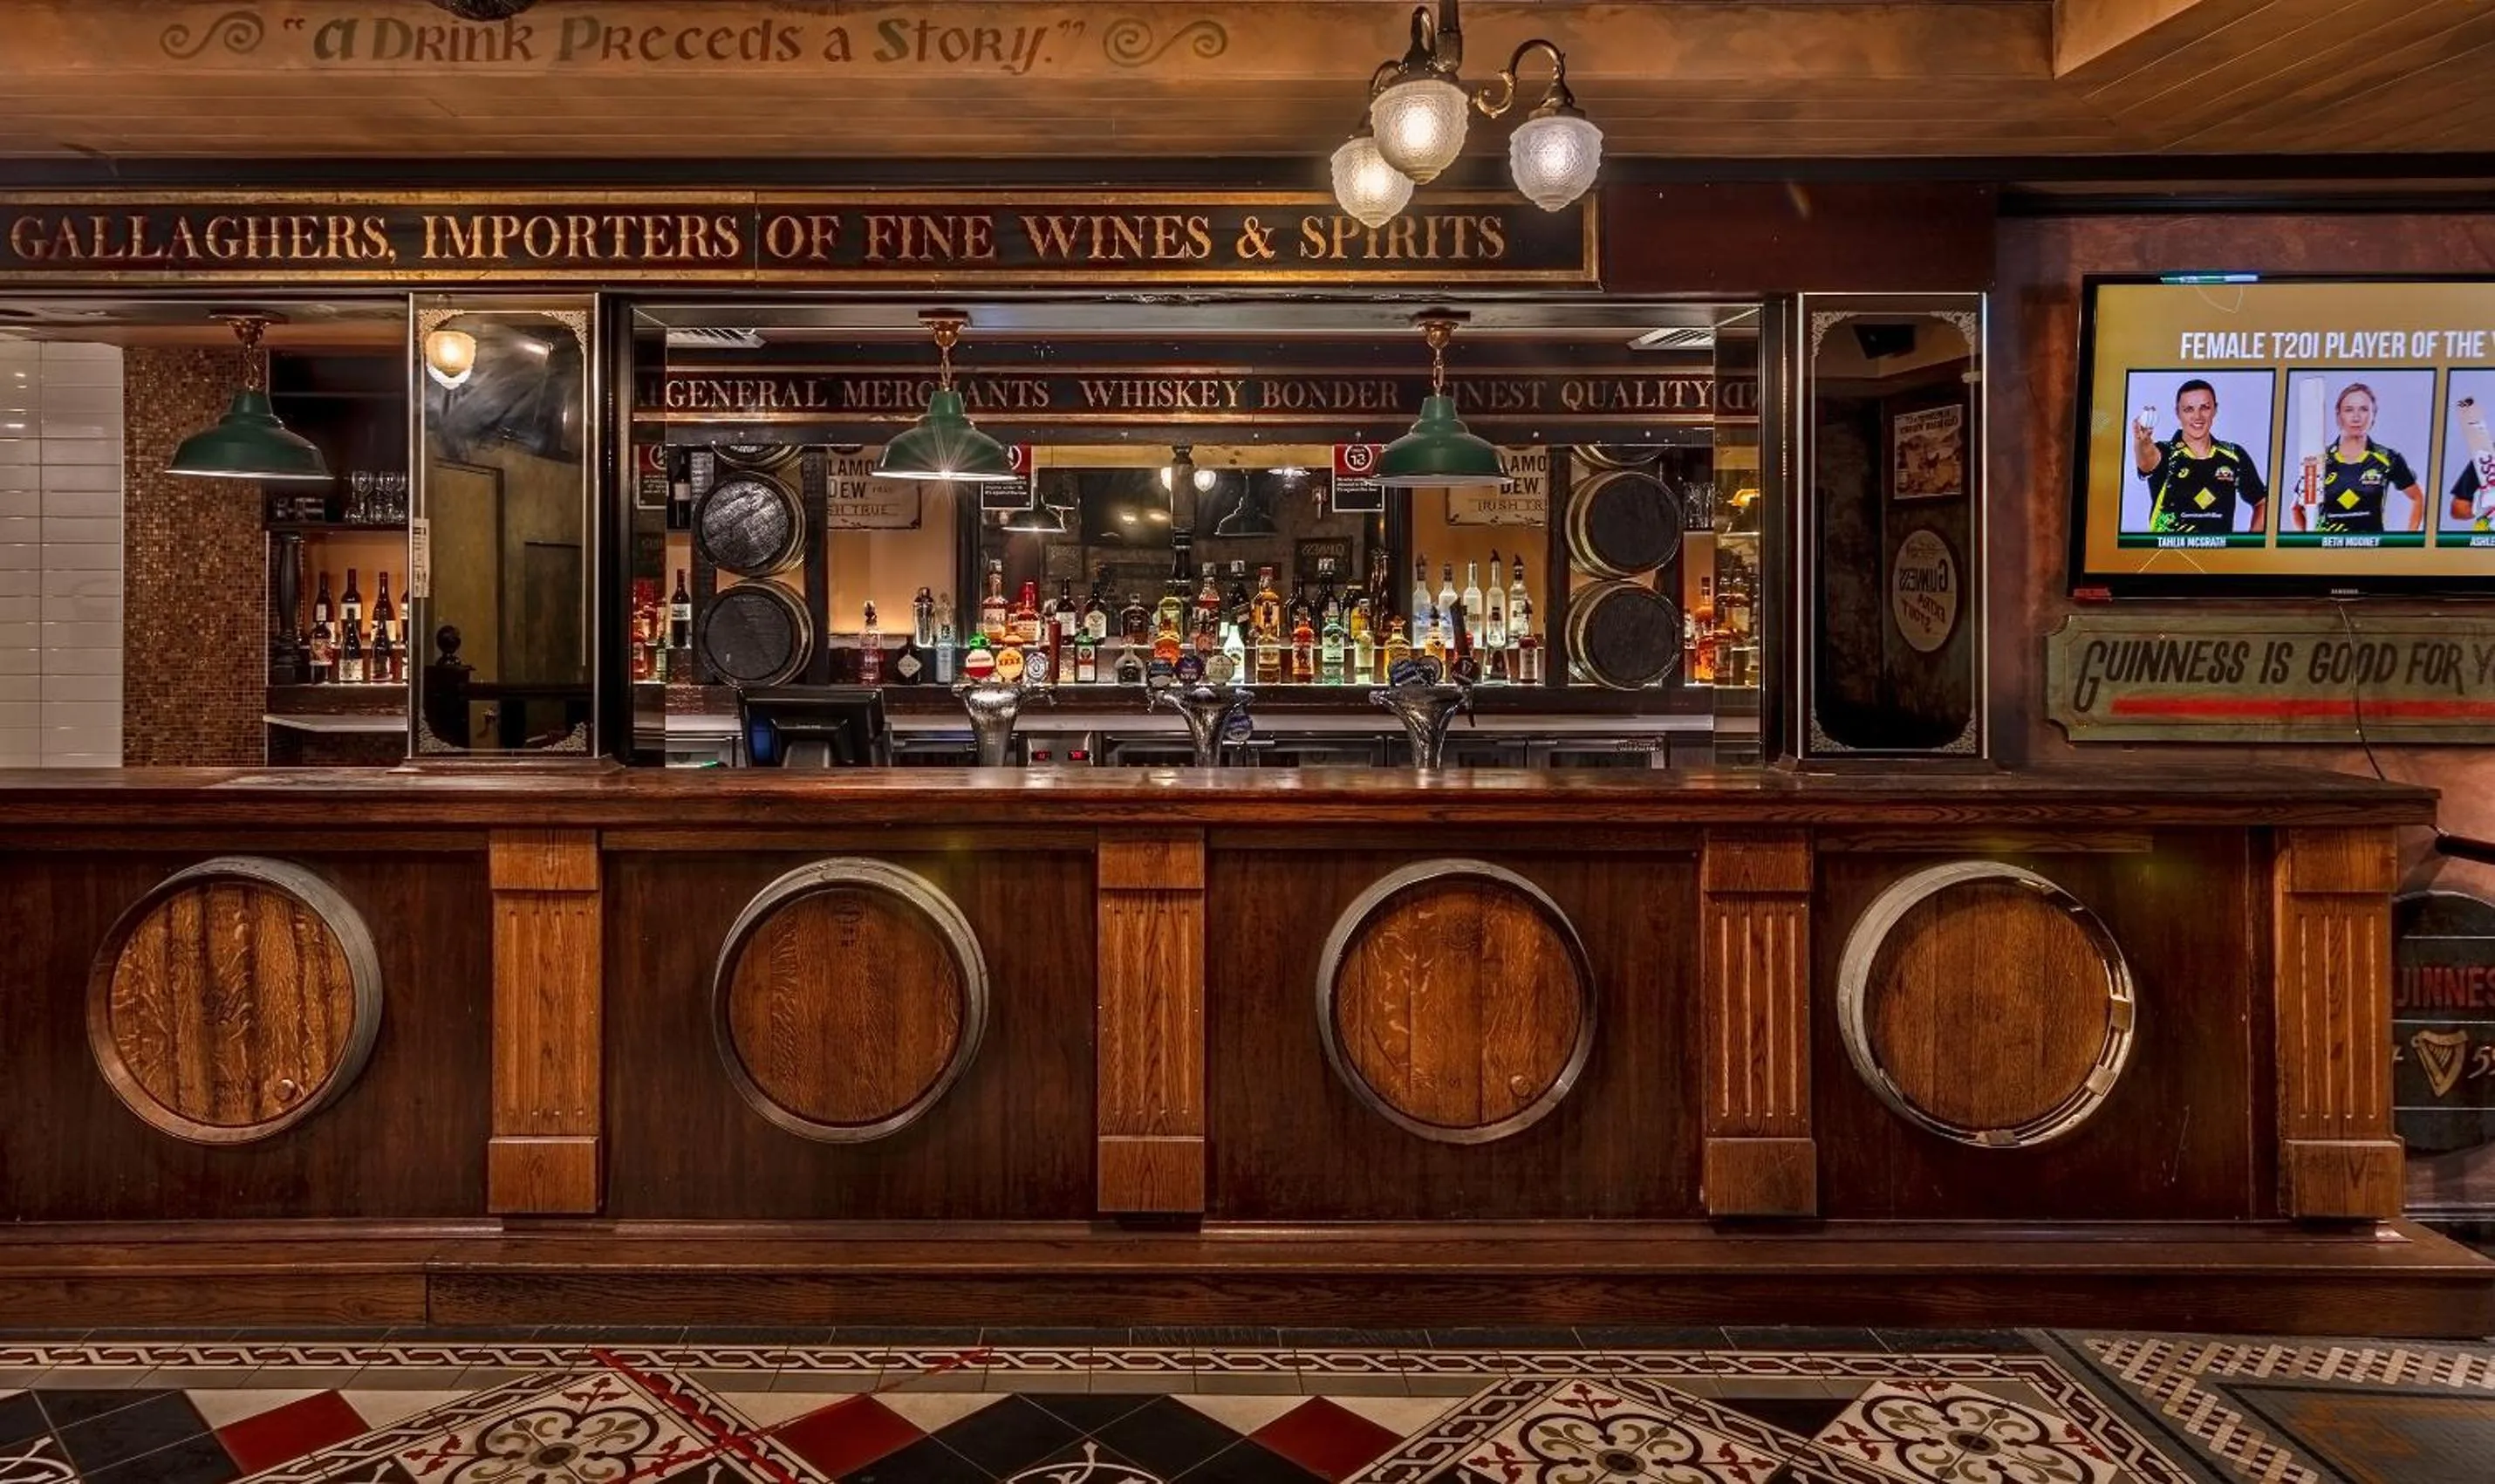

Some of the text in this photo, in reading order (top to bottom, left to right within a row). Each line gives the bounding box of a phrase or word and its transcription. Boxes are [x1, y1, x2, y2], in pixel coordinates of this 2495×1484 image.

[10, 215, 1506, 263] GALLAGHERS, IMPORTERS OF FINE WINES & SPIRITS
[2180, 332, 2266, 359] FEMALE
[2325, 332, 2405, 359] PLAYER
[2410, 332, 2440, 358] OF
[2444, 331, 2485, 358] THE
[666, 379, 830, 408] GENERAL
[844, 380, 1049, 408] MERCANTS
[1079, 380, 1246, 408] WHISKEY
[1262, 380, 1400, 409] BONDER
[1443, 380, 1548, 409] INEST
[1562, 380, 1714, 410] QUALITY
[2073, 639, 2495, 713] GUINNESS IS GOOD FOR Y
